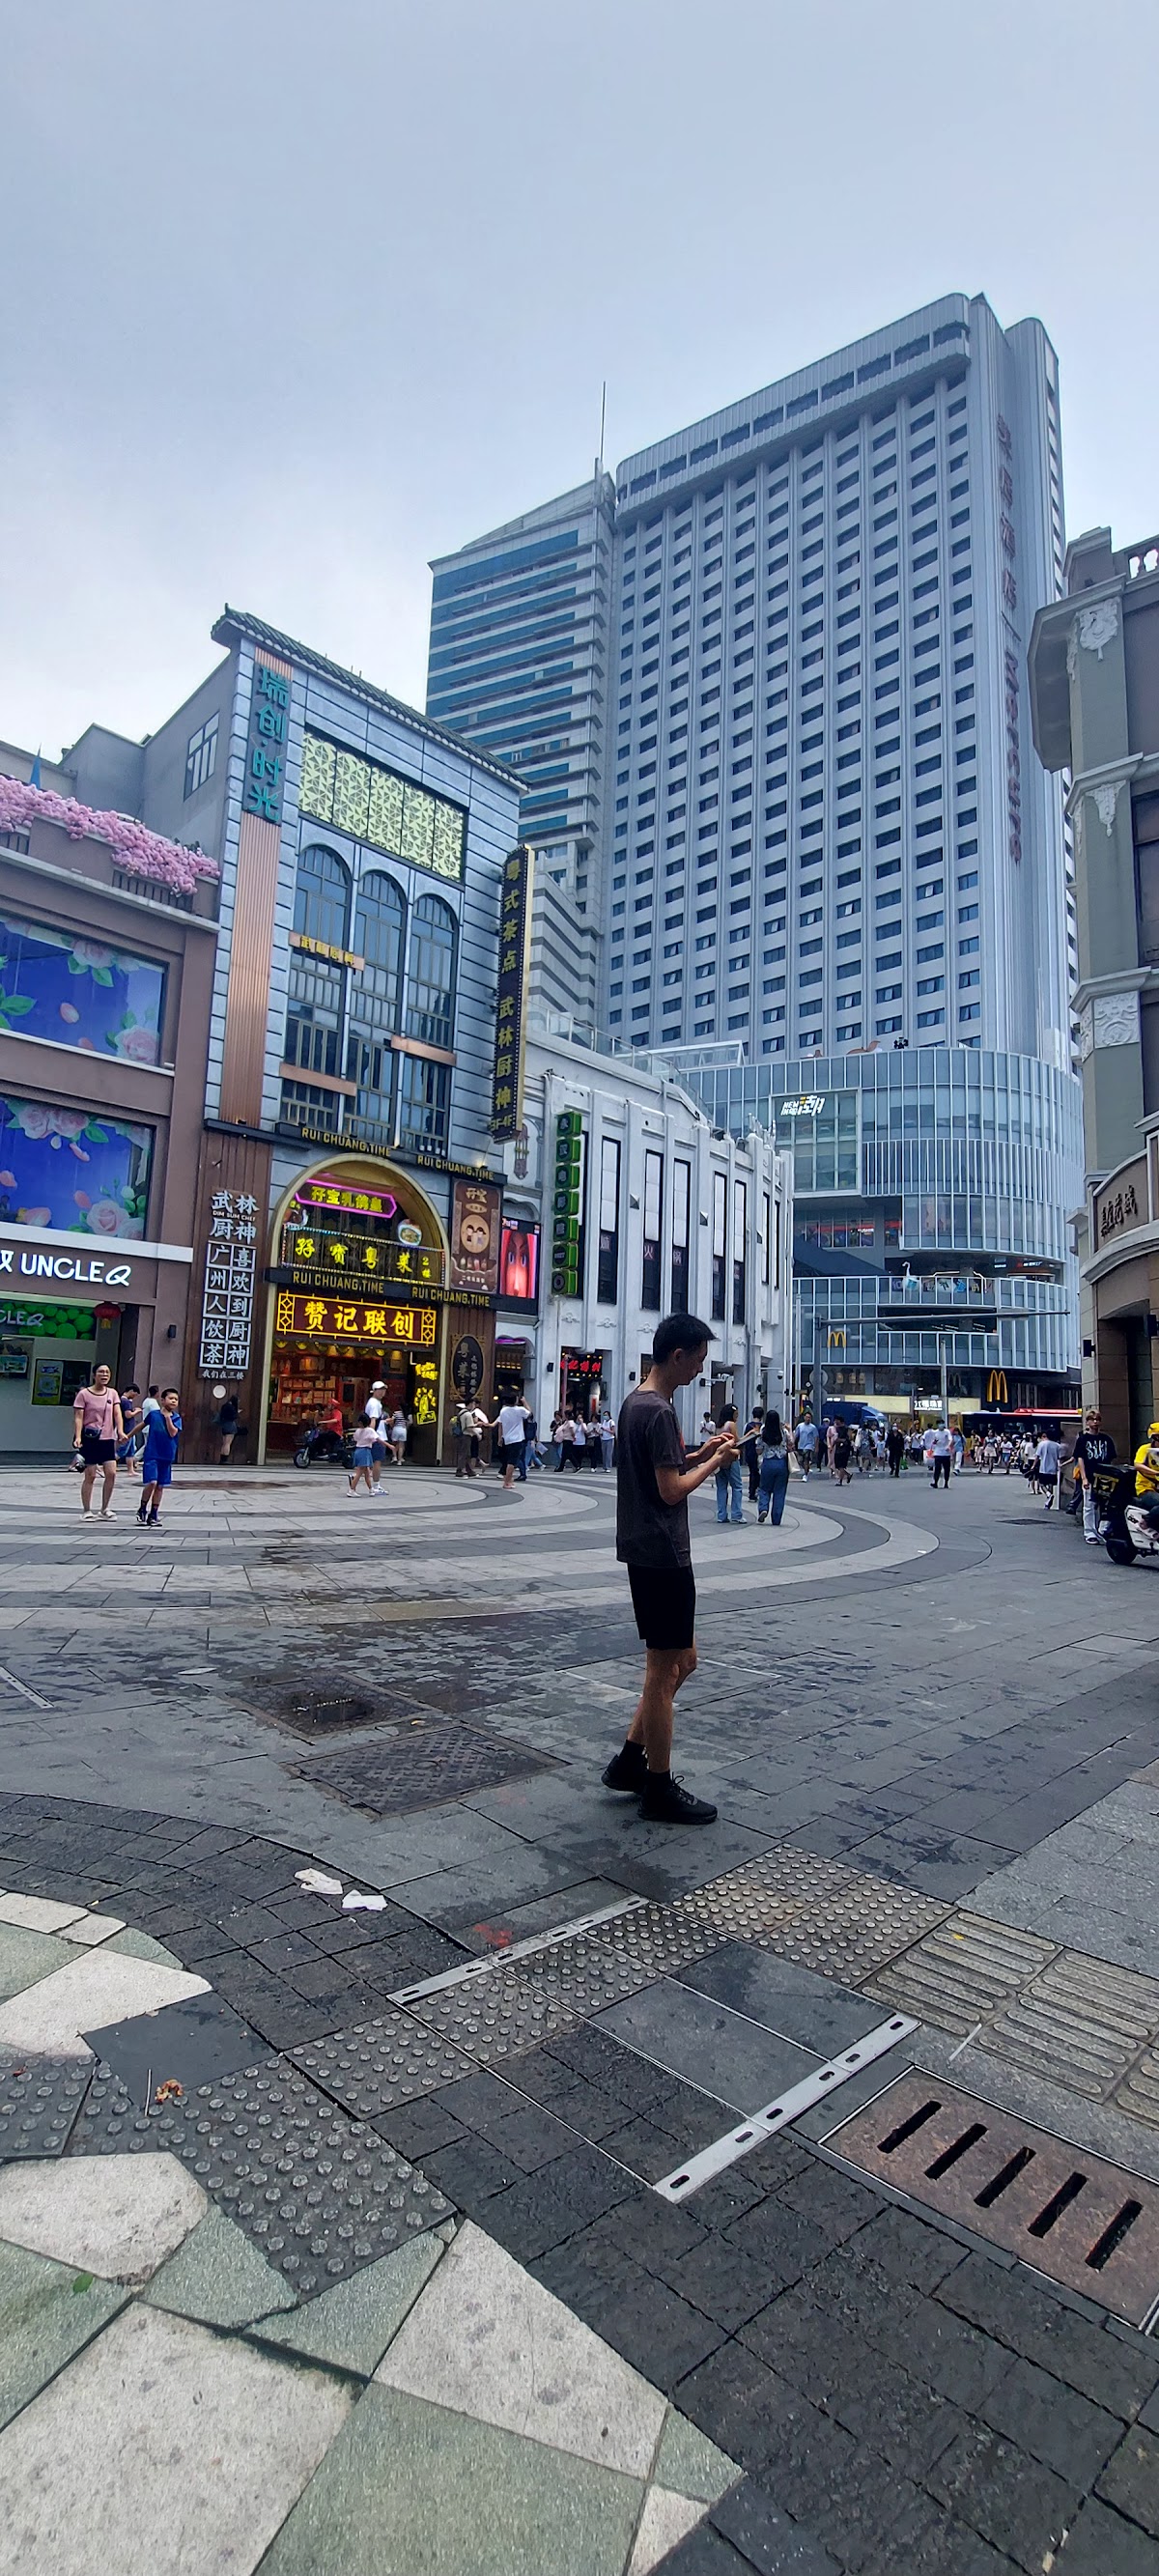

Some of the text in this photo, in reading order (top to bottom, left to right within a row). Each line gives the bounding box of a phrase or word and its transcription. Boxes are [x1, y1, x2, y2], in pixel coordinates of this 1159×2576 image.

[301, 1127, 320, 1141] RUI
[417, 1155, 434, 1167] RUI
[211, 1190, 260, 1215] 武林
[210, 1217, 257, 1244] 厨神
[293, 1271, 311, 1285] RUI
[411, 1287, 428, 1299] RUI
[303, 1300, 415, 1340] 赞记联创
[201, 1368, 245, 1381] 我们在三楼
